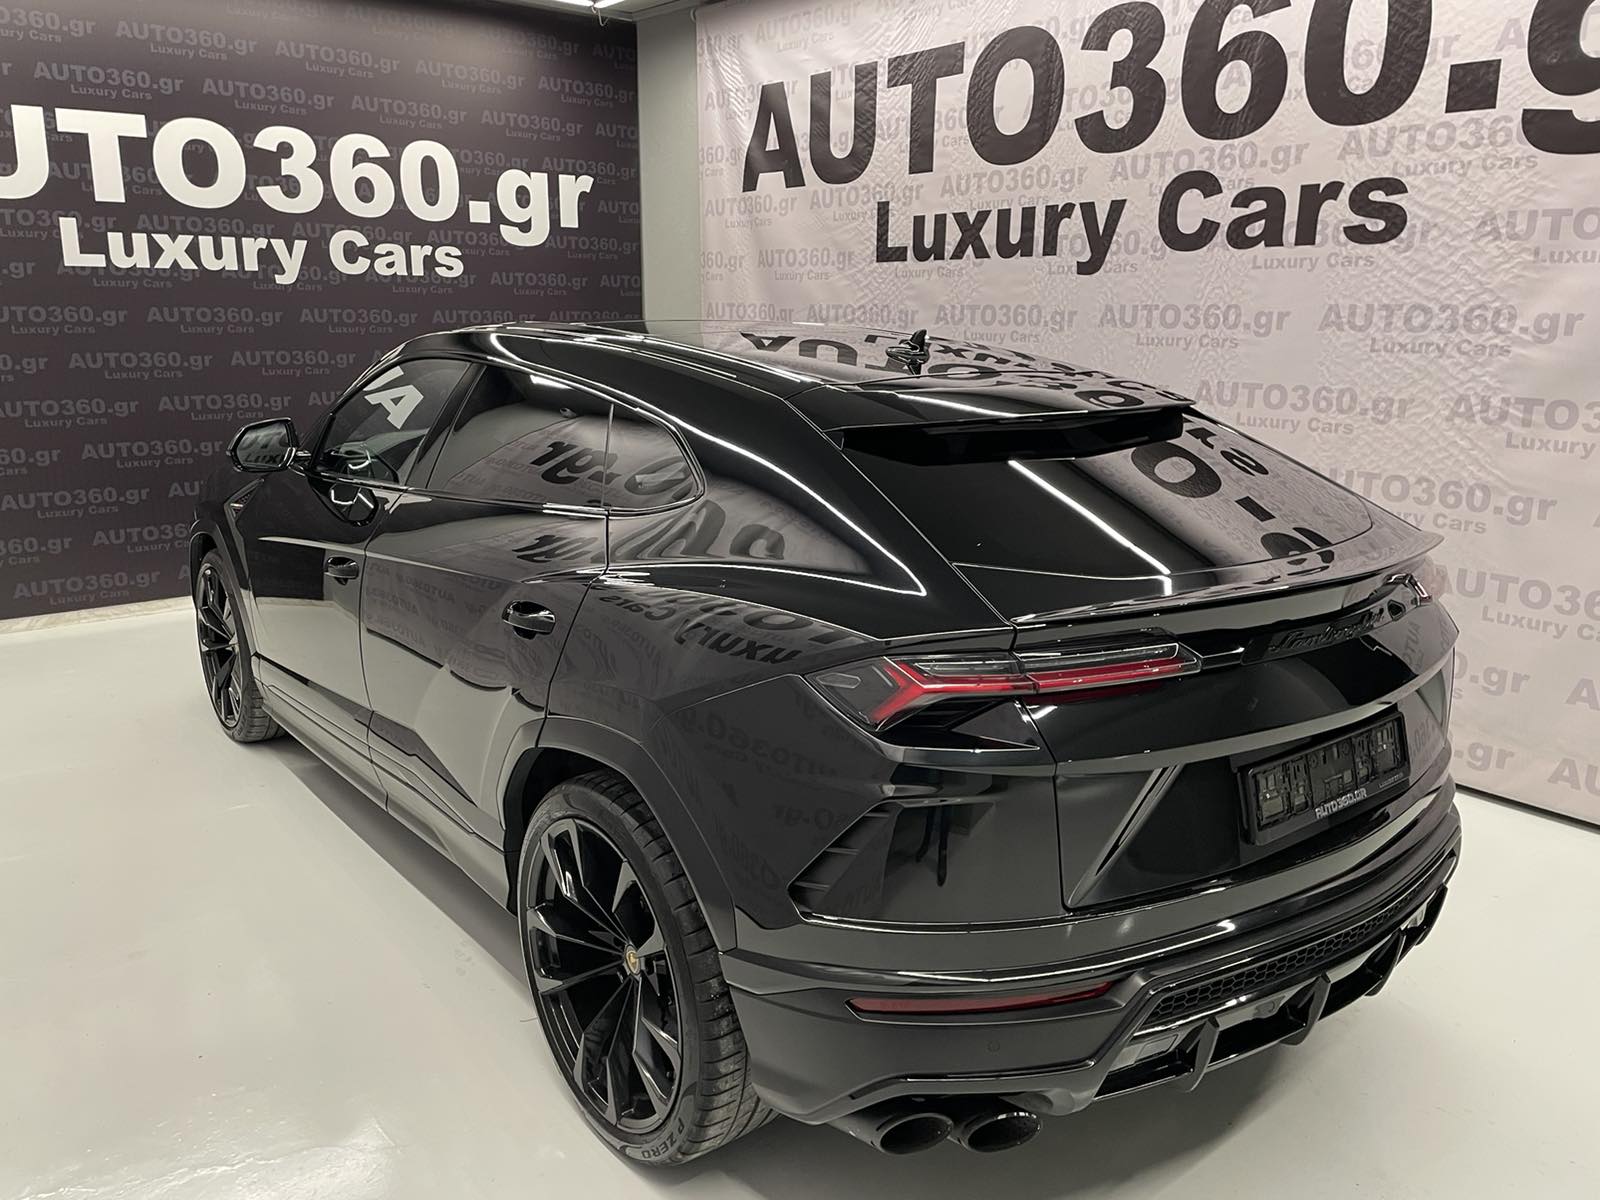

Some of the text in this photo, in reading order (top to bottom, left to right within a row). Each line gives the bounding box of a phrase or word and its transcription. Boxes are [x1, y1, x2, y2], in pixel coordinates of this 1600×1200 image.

[28, 30, 62, 43] Cars
[115, 20, 258, 56] AUTO360.gr
[150, 43, 227, 61] Luxury Cars
[275, 39, 400, 74] AUTO360.gr
[34, 61, 184, 95] AUTO360.gr
[306, 62, 374, 78] Luxury Cars
[416, 59, 525, 88] AUTO360.gr
[70, 84, 152, 100] Luxury Cars
[202, 77, 334, 110] AUTO360.gr
[441, 79, 501, 94] Luxury Cars
[538, 76, 635, 103] AUTO360.gr
[235, 99, 307, 115] Luxury Cars
[561, 93, 614, 108] Luxury Cars
[351, 95, 467, 125] AUTO360.gr
[379, 115, 442, 129] Luxury Cars
[480, 110, 583, 137] AUTO360.gr
[505, 128, 561, 142] Luxury Cars
[542, 156, 637, 179] AUTO360.gr
[1108, 141, 1311, 182] AUTO360.gr
[1392, 153, 1539, 178] Luxury Cars
[131, 184, 163, 196] Cars
[940, 164, 1088, 199] AUTO360.gr
[809, 182, 924, 210] AUTO360.gr
[705, 194, 798, 217] AUTO360.gr
[876, 170, 1409, 275] Luxury Cars
[0, 229, 48, 240] Luxury
[58, 216, 465, 285] Luxury Cars
[489, 248, 511, 256] Cars
[545, 236, 639, 253] AUTO360.gr
[568, 251, 596, 260] Luxury
[757, 248, 855, 268] AUTO360.gr
[1252, 252, 1375, 272] Luxury Cars
[92, 278, 173, 289] Luxury Cars
[490, 272, 588, 289] AUTO360.gr
[774, 270, 832, 281] Luxury Cars
[296, 283, 323, 292] Cars
[392, 285, 453, 296] Luxury Cars
[514, 288, 567, 297] Luxury Cars
[146, 306, 284, 327] AUTO360.gr
[300, 307, 418, 325] AUTO360.gr
[706, 303, 794, 322] AUTO360.gr
[935, 304, 1077, 332] AUTO360.gr
[1098, 304, 1291, 337] AUTO360.gr
[11, 325, 96, 336] Luxury Cars
[180, 325, 255, 336] Luxury Cars
[328, 324, 392, 334] Luxury Cars
[1316, 303, 1585, 344] AUTO360.gr
[963, 329, 1040, 344] Luxury Cars
[1135, 332, 1240, 350] Luxury Cars
[1369, 338, 1512, 357] Luxury Cars
[68, 351, 213, 370] AUTO360.gr
[231, 350, 356, 368] AUTO360.gr
[104, 369, 184, 381] Luxury Cars
[262, 366, 330, 377] Luxury Cars
[158, 392, 291, 412] AUTO360.gr
[1196, 380, 1414, 424] AUTO360.gr
[24, 416, 107, 429] Luxury Cars
[191, 409, 264, 422] Luxury Cars
[1237, 415, 1354, 435] Luxury Cars
[80, 439, 223, 461] AUTO360.gr
[1505, 432, 1596, 459] Luxury
[116, 455, 193, 469] Luxury Cars
[1, 486, 150, 511] AUTO360.gr
[37, 503, 119, 520] Luxury Cars
[1432, 511, 1487, 534] Cars
[128, 542, 171, 552] Luxury
[8, 554, 40, 565] Cars
[13, 569, 160, 599] AUTO360.gr
[50, 589, 129, 605] Luxury Cars
[1481, 606, 1569, 640] Luxury
[641, 1118, 684, 1159] P ZERO
